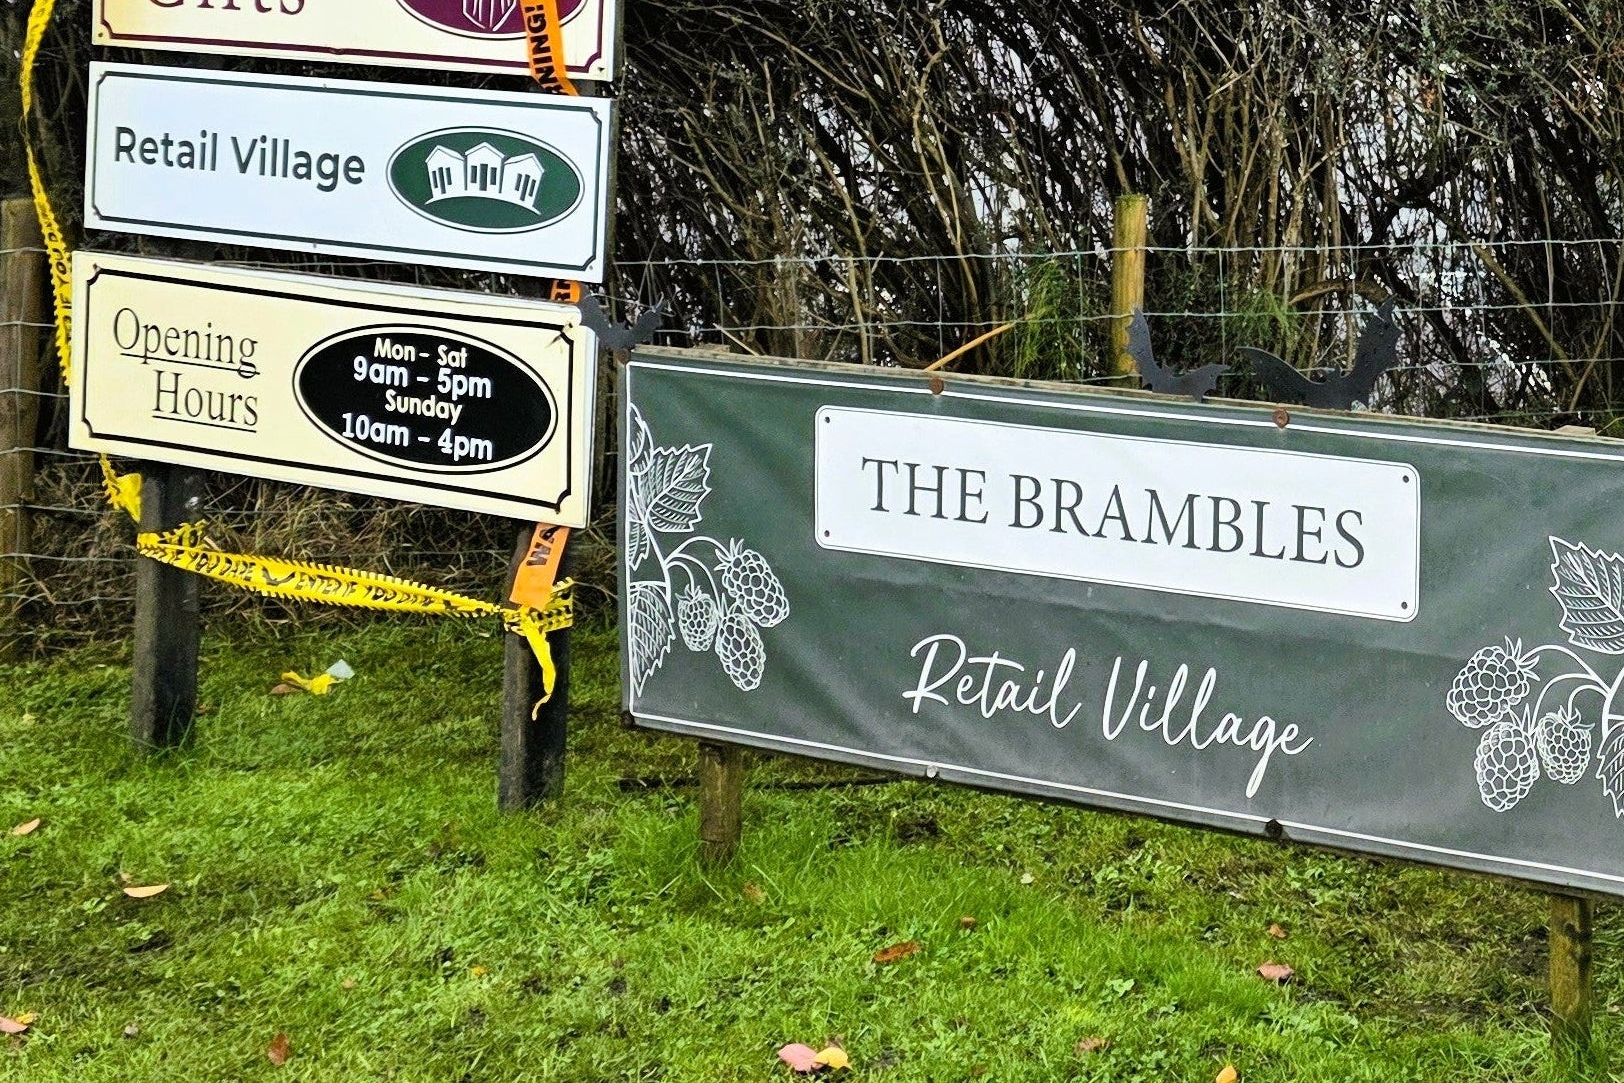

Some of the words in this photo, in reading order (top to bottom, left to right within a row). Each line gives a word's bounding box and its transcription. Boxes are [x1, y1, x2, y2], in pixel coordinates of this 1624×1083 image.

[113, 126, 218, 172] Retail
[230, 136, 366, 193] Village
[112, 307, 259, 376] Opening
[374, 337, 416, 361] Mon
[437, 344, 468, 368] Sat
[153, 370, 258, 426] Hours
[353, 356, 409, 387] 9am
[437, 367, 492, 401] 5pm
[384, 388, 463, 425] Sunday
[342, 412, 410, 447] 10am
[437, 428, 493, 461] 4pm
[862, 456, 989, 524] THE
[1008, 474, 1366, 569] BRAMBLES
[187, 551, 221, 574] YOU
[362, 585, 398, 602] YOU
[902, 634, 1082, 728] Retail
[1102, 656, 1314, 799] Village
